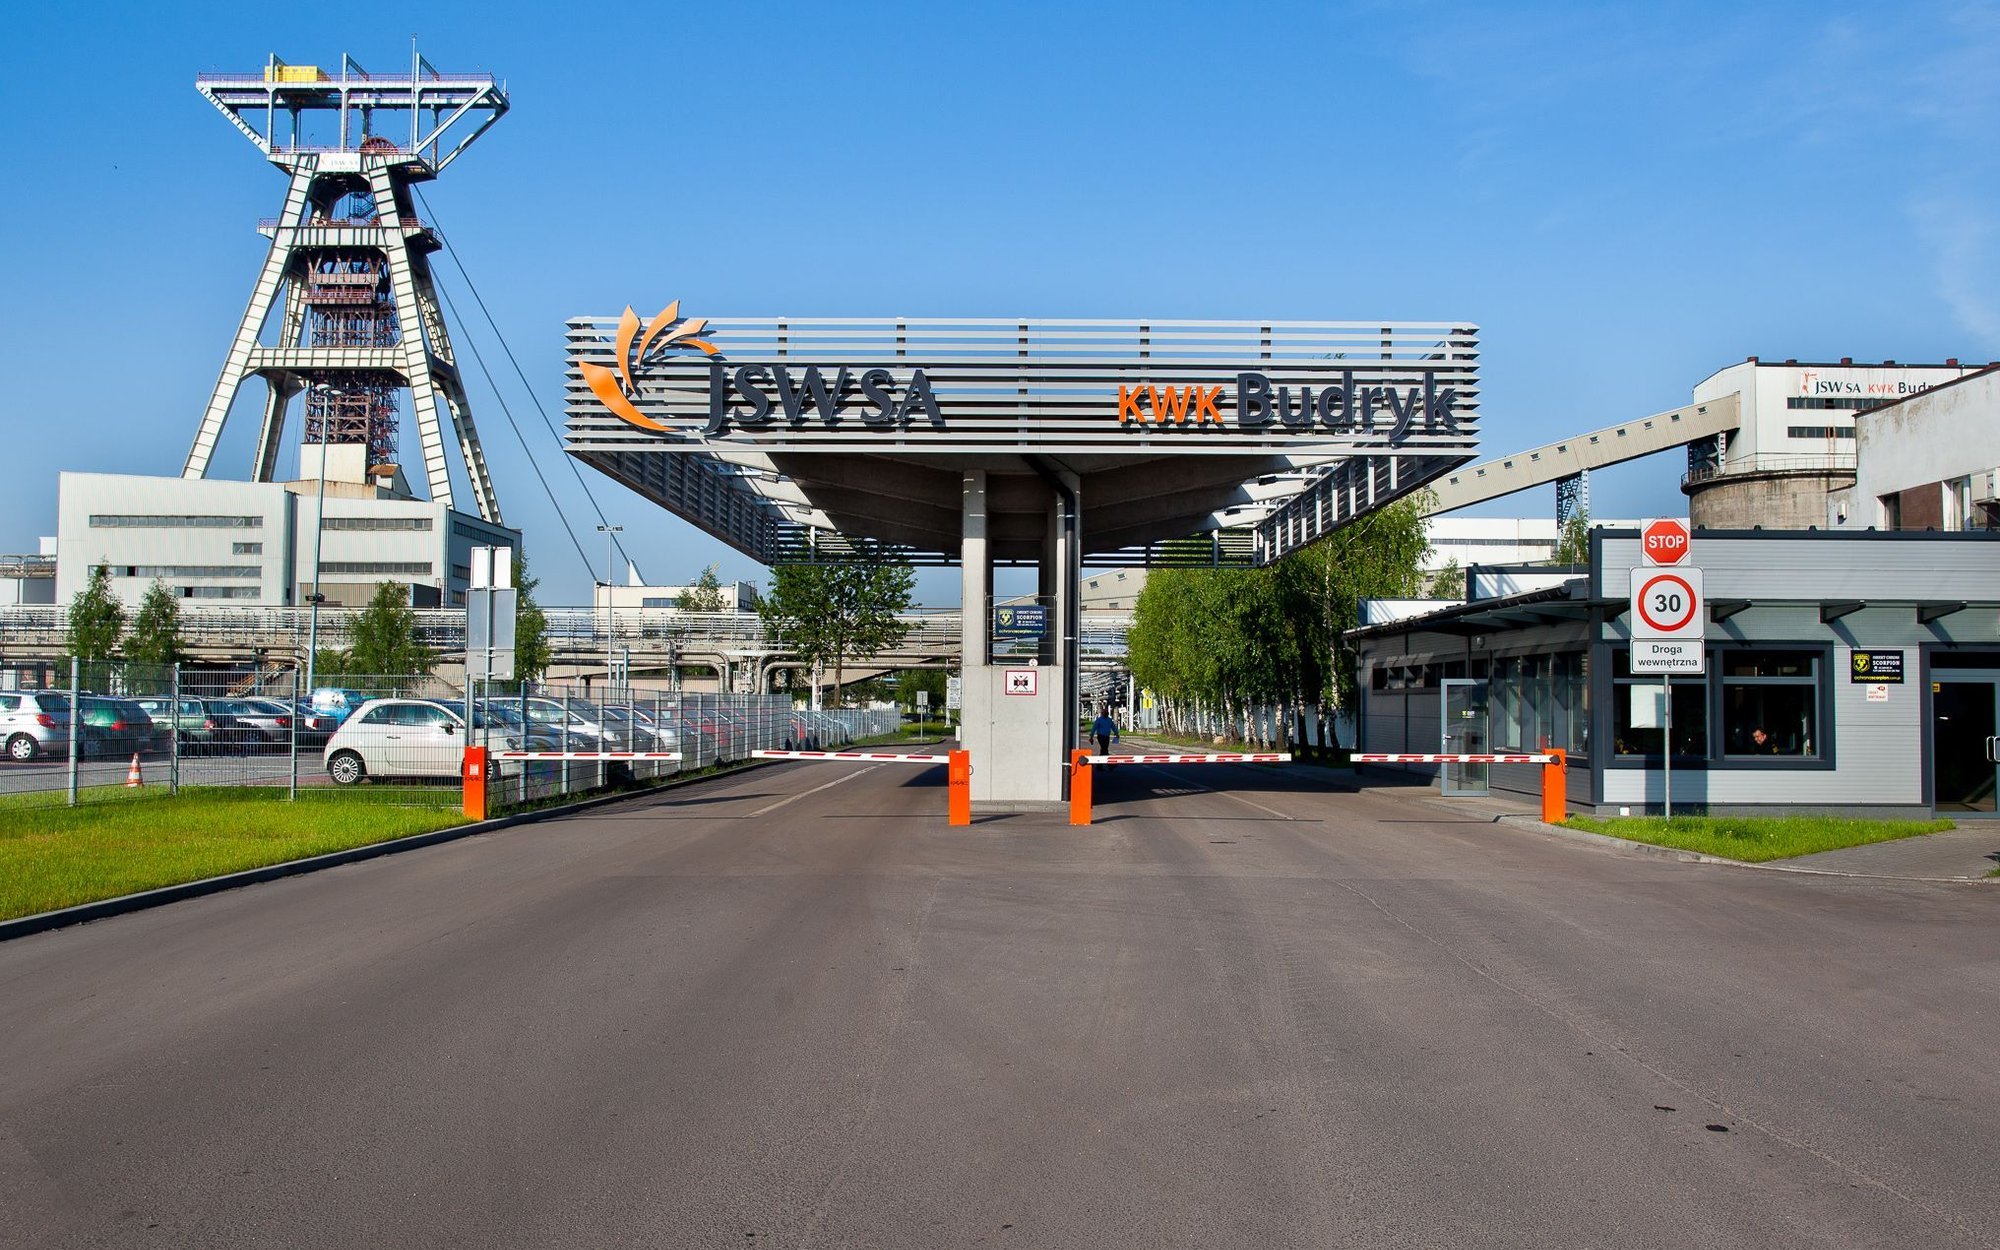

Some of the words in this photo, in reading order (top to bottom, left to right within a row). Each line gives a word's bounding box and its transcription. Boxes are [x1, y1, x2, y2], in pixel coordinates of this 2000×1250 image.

[1815, 381, 1843, 395] JSW
[1845, 383, 1861, 394] SA
[1868, 383, 1895, 394] KWK
[703, 364, 848, 434] JSW
[860, 369, 942, 422] SA
[1118, 386, 1224, 423] KWK
[1237, 371, 1456, 441] Budryk
[1648, 535, 1685, 549] STOP
[1655, 594, 1681, 613] 30
[1652, 645, 1682, 656] Droga
[1638, 658, 1698, 668] wewnętrzna
